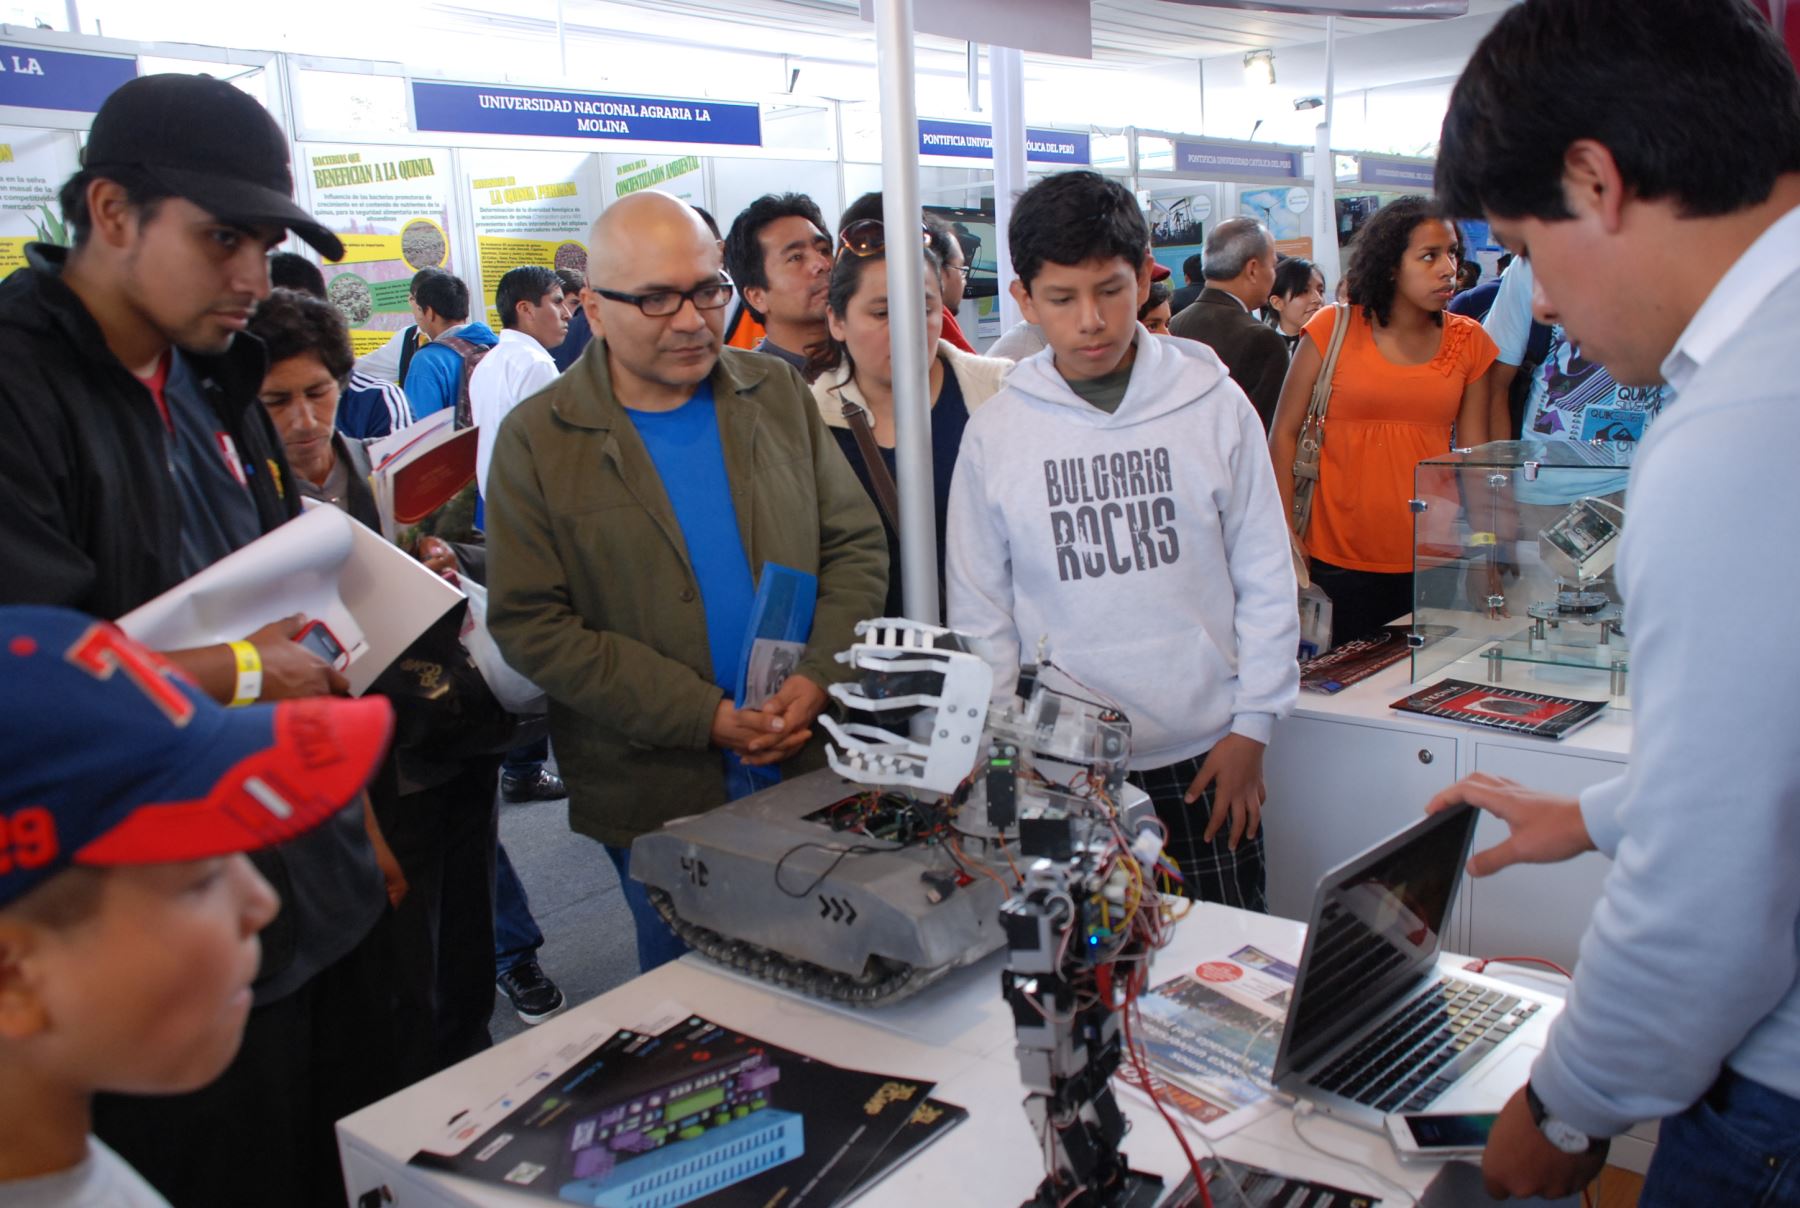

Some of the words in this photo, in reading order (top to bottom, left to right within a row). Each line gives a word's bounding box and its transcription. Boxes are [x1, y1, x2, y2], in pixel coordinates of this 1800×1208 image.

[11, 55, 45, 76] LA
[478, 94, 572, 113] UNIVERSIDAD
[573, 100, 639, 117] NACIONAL
[640, 104, 693, 121] AGRARIA
[694, 108, 712, 122] LA
[576, 118, 630, 134] MOLINA
[922, 133, 966, 147] PONTIFICIA
[1046, 143, 1059, 154] DEL
[1059, 143, 1075, 155] PERÚ
[313, 164, 374, 189] BENEFICIAN
[374, 163, 384, 182] A
[383, 161, 398, 181] LA
[398, 157, 435, 181] QUINUA
[1050, 496, 1181, 582] ROCKS
